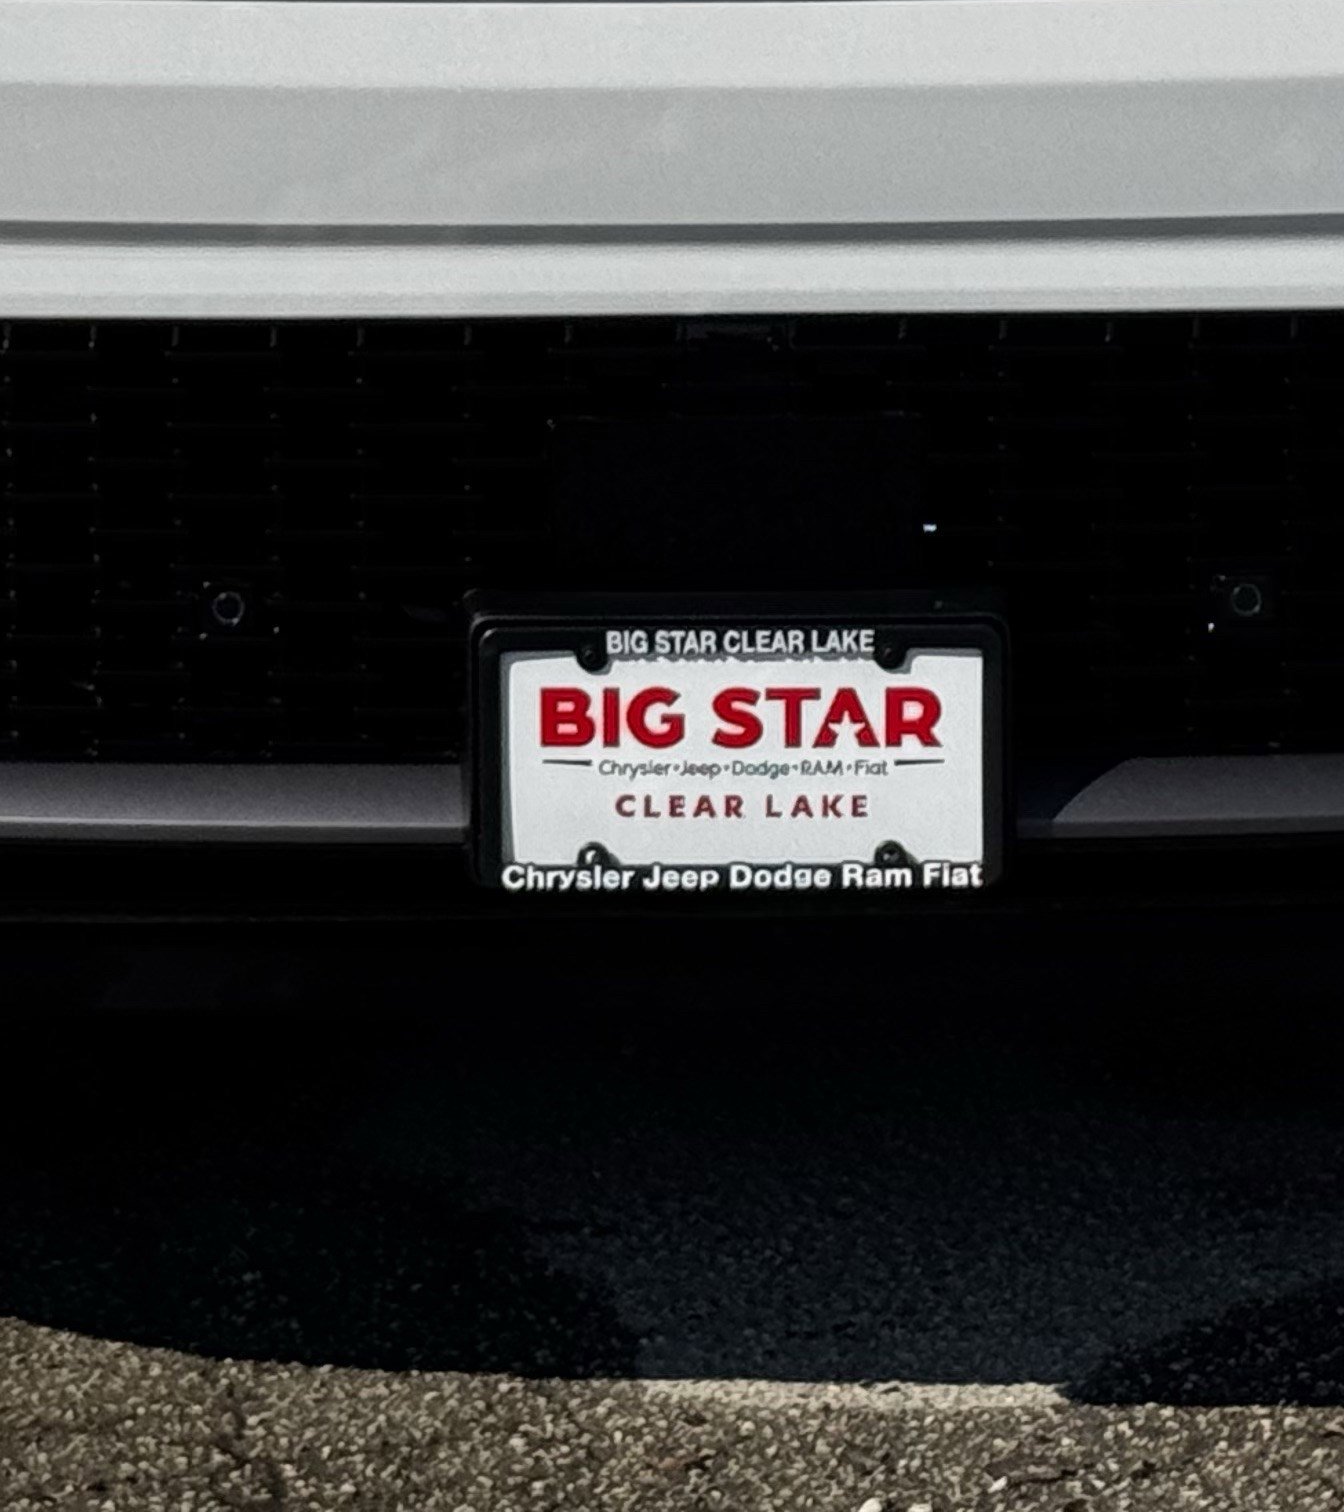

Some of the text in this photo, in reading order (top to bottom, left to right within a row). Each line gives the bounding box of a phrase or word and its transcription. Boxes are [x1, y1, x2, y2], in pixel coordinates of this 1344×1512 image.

[606, 629, 875, 654] BIG STAR CLEAR LAKE
[539, 686, 943, 749] BIG STAR
[615, 794, 869, 819] CLEAR LAKE
[501, 861, 984, 891] Chrysler Jeep Dodge Ram Fiat
